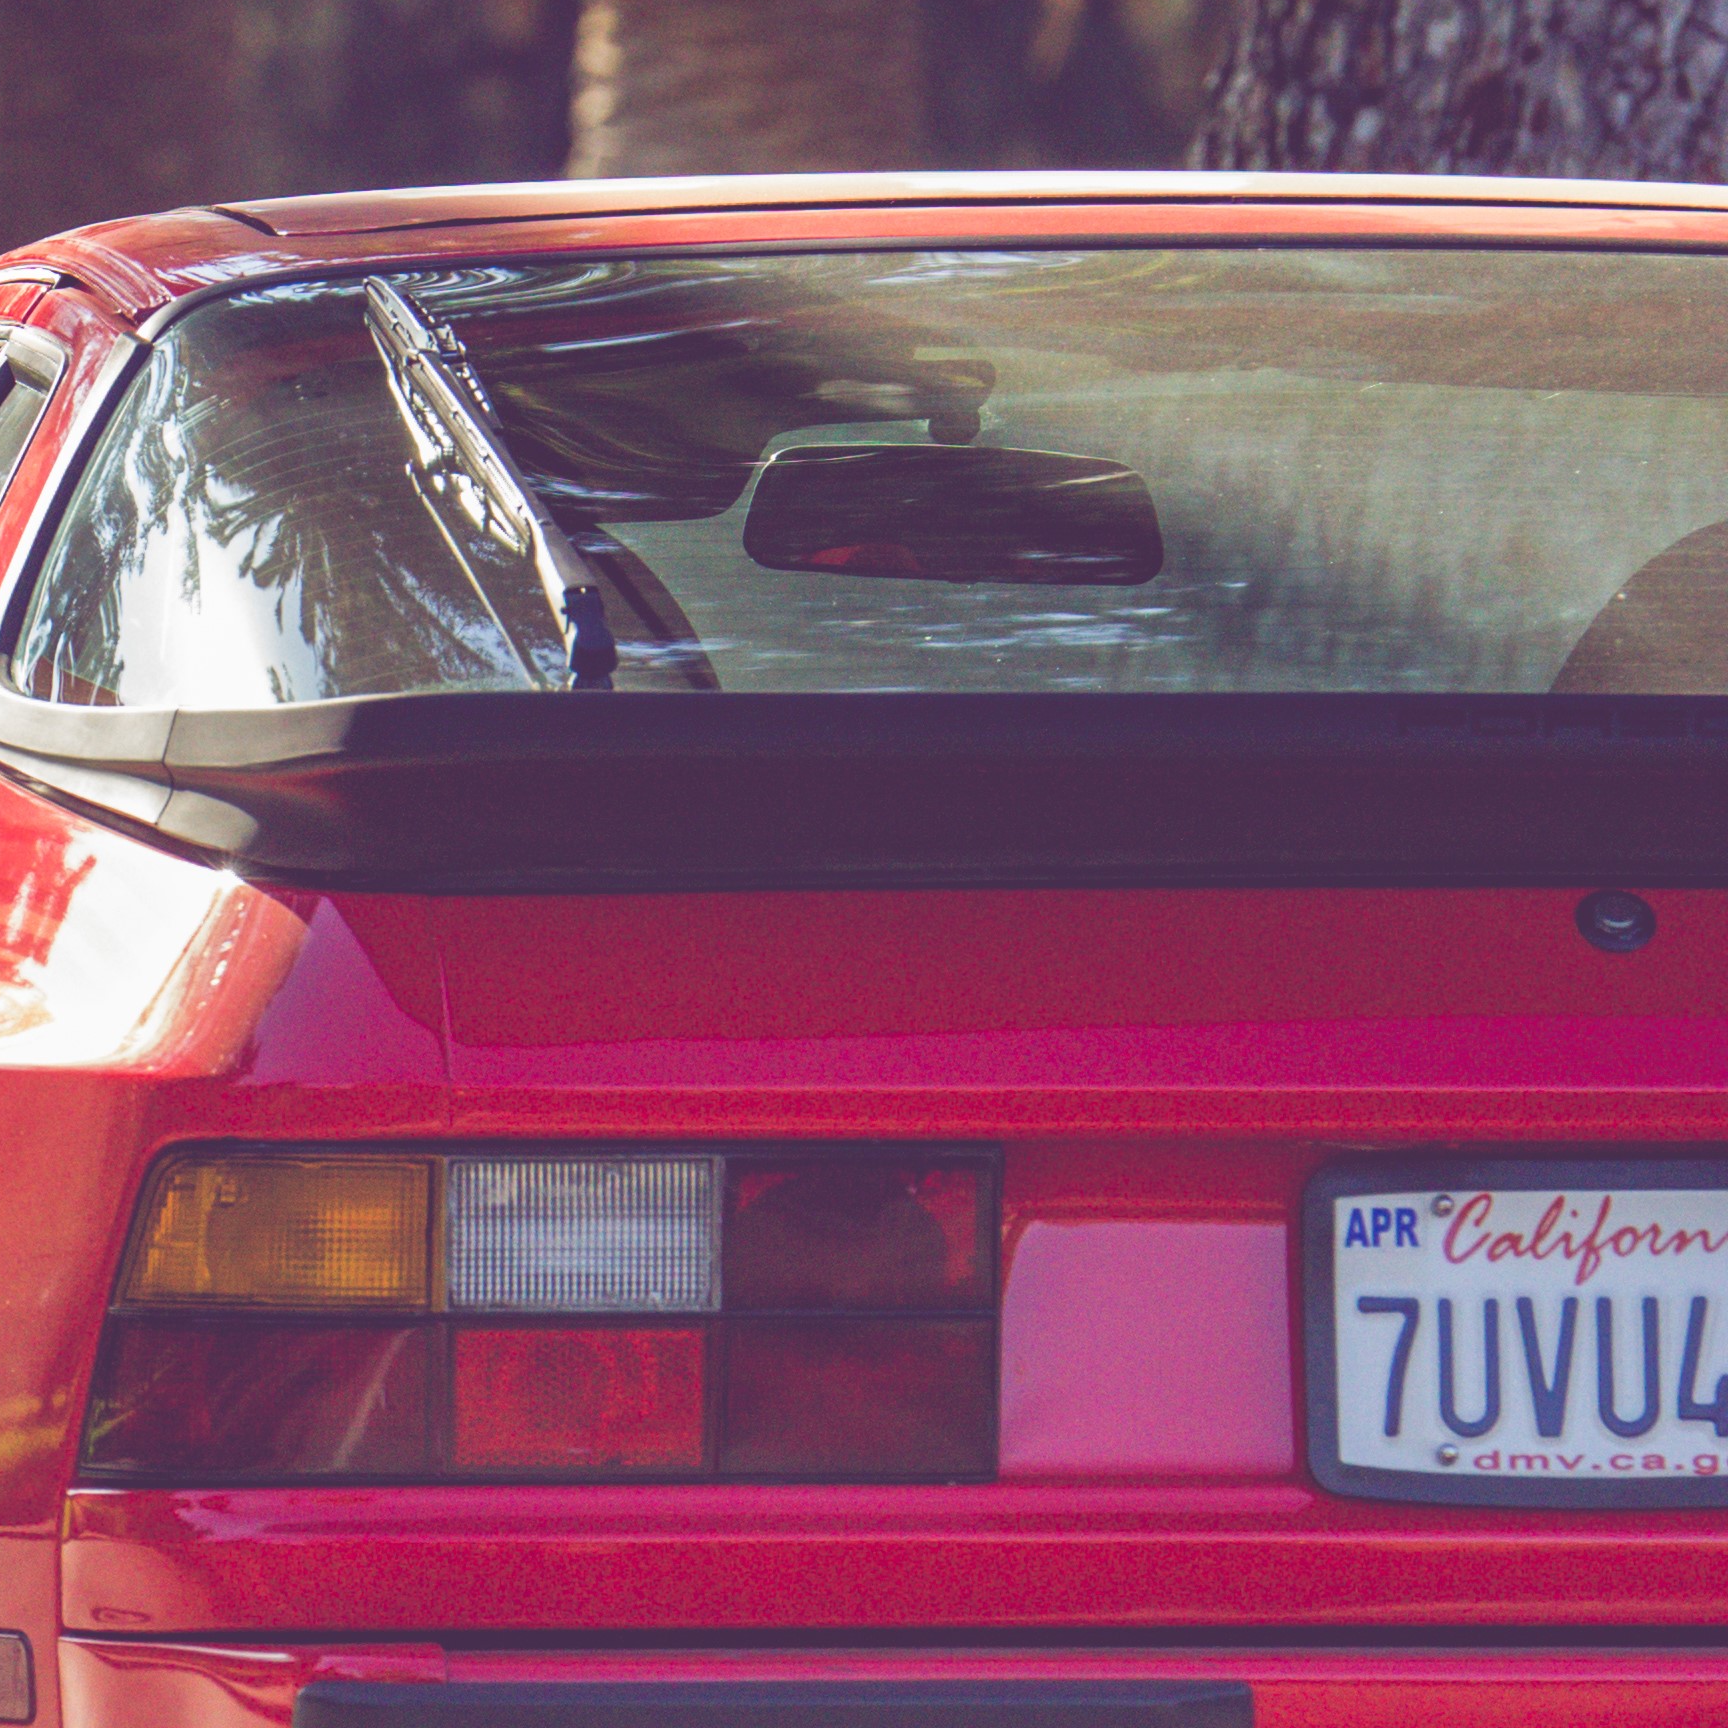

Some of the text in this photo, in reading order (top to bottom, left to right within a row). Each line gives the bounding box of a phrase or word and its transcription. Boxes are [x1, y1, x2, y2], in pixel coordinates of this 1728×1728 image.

[1345, 1207, 1420, 1248] APR
[1357, 1296, 1728, 1438] 7UVU4
[1473, 1450, 1728, 1476] dmv.ca.g
